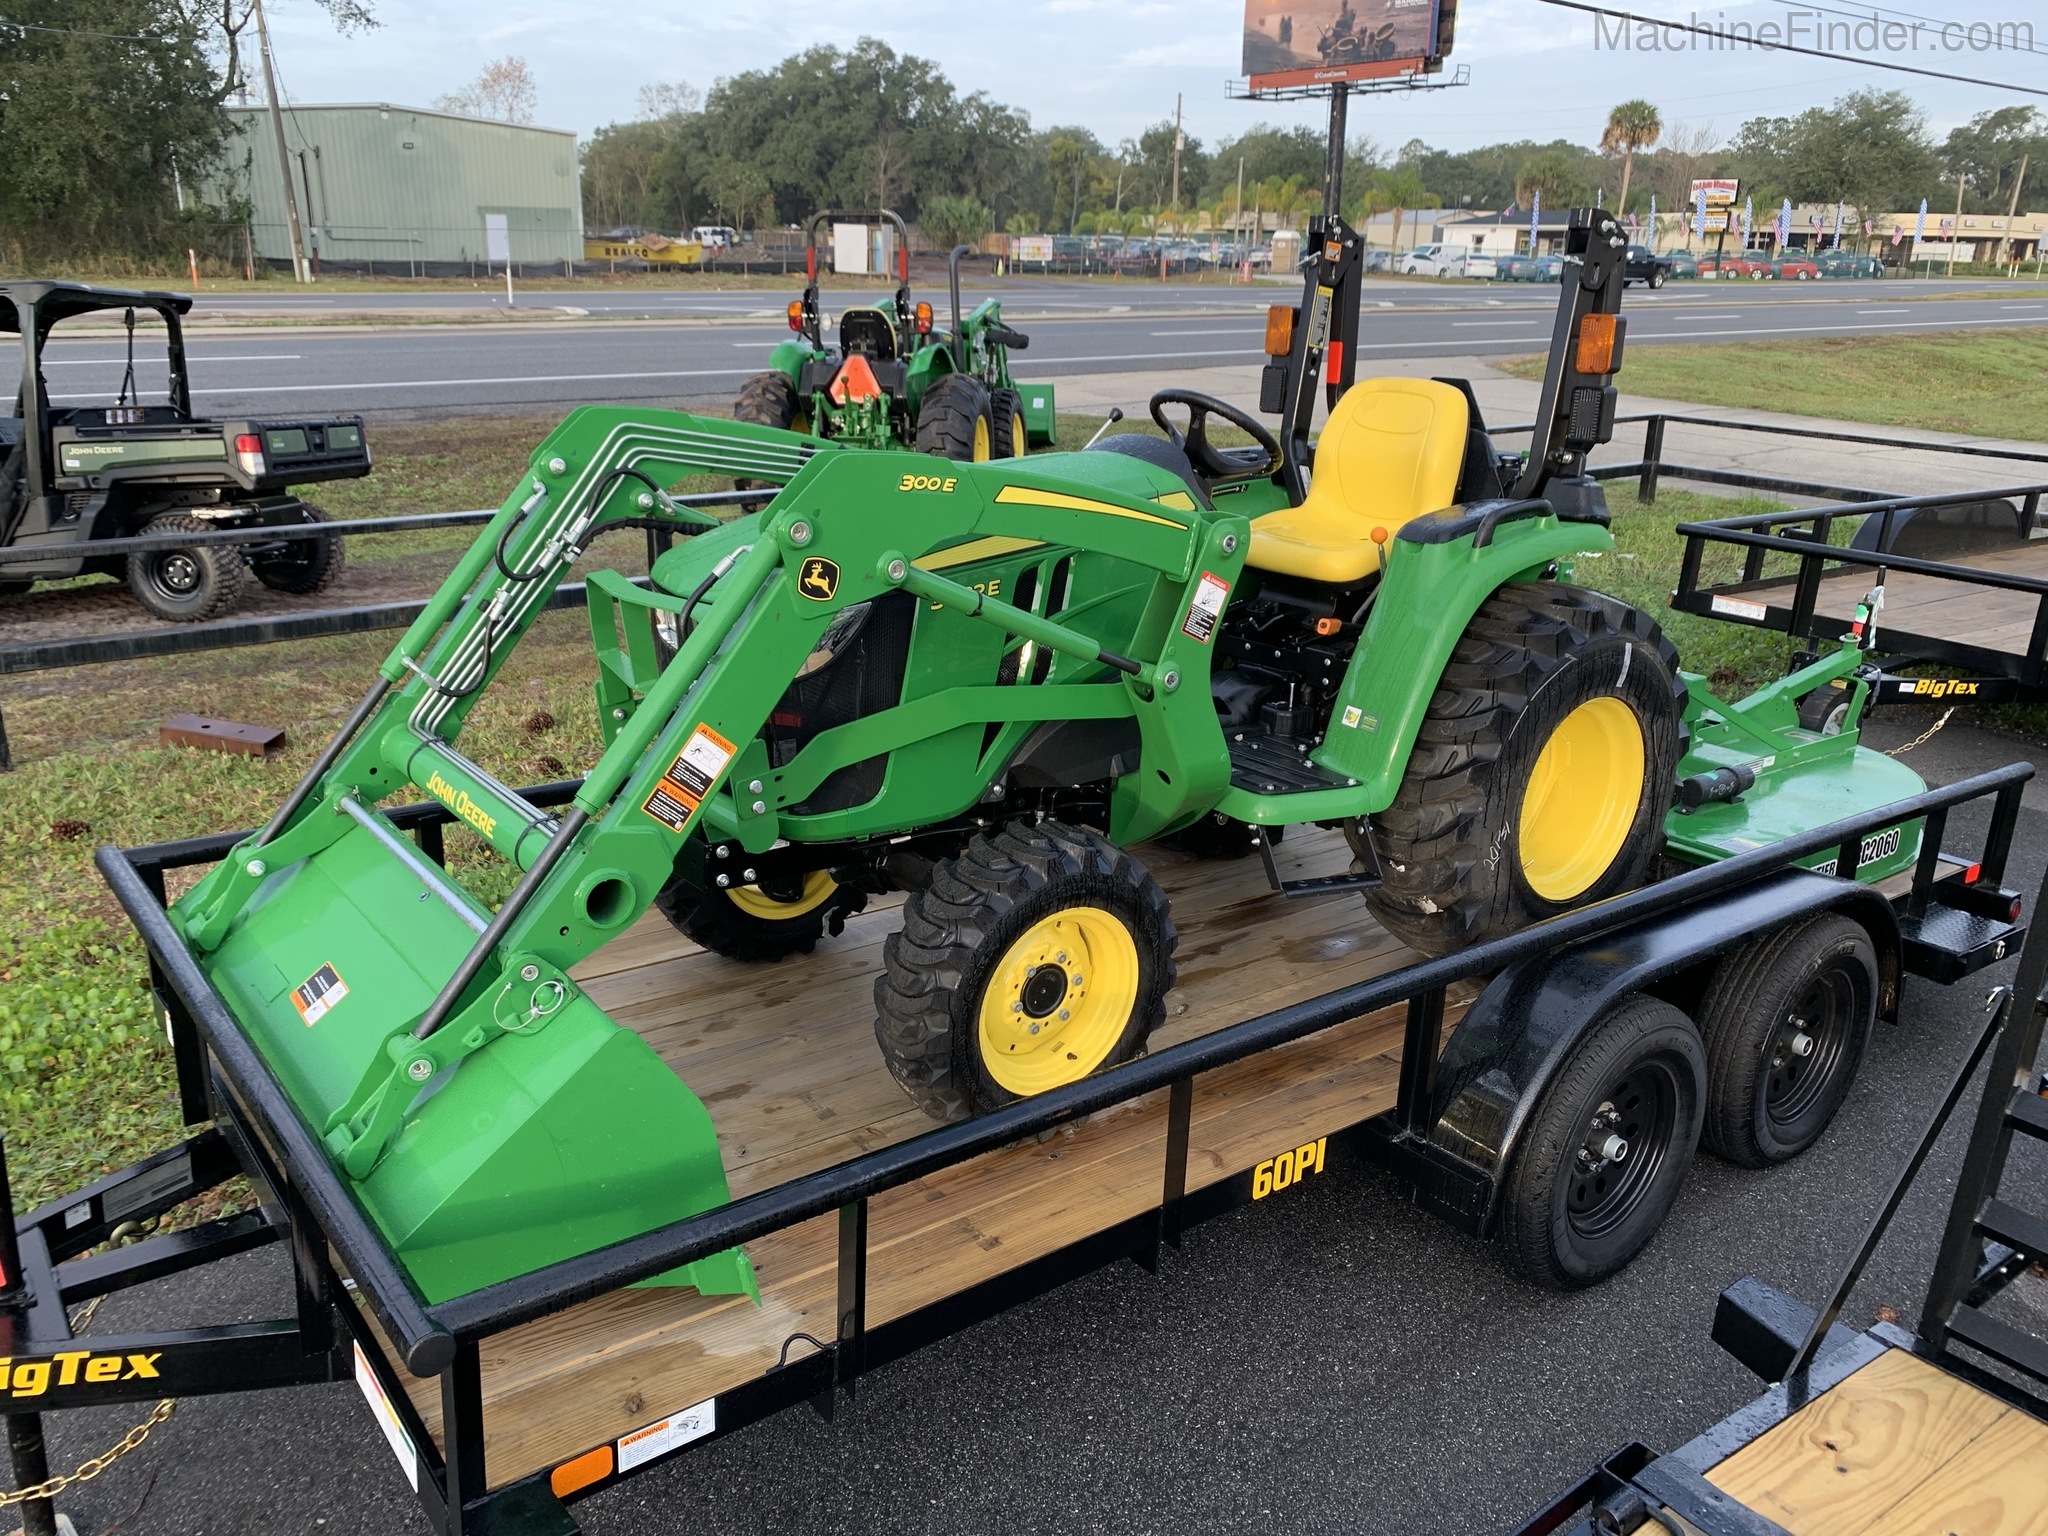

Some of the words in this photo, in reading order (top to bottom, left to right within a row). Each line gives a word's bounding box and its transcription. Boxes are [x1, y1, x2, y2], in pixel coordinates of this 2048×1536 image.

[69, 447, 93, 456] JOHN
[94, 446, 124, 454] DEERE
[1210, 577, 1227, 589] DANGER
[1914, 679, 1980, 698] BigTex
[708, 731, 732, 752] WARNING
[426, 769, 458, 808] JOHN
[456, 790, 497, 840] DEERE
[669, 788, 694, 808] WARNING
[1858, 829, 1900, 867] C2060
[1252, 1136, 1327, 1201] 60PI
[0, 1351, 162, 1397] igTex
[630, 1424, 664, 1444] WARNING
